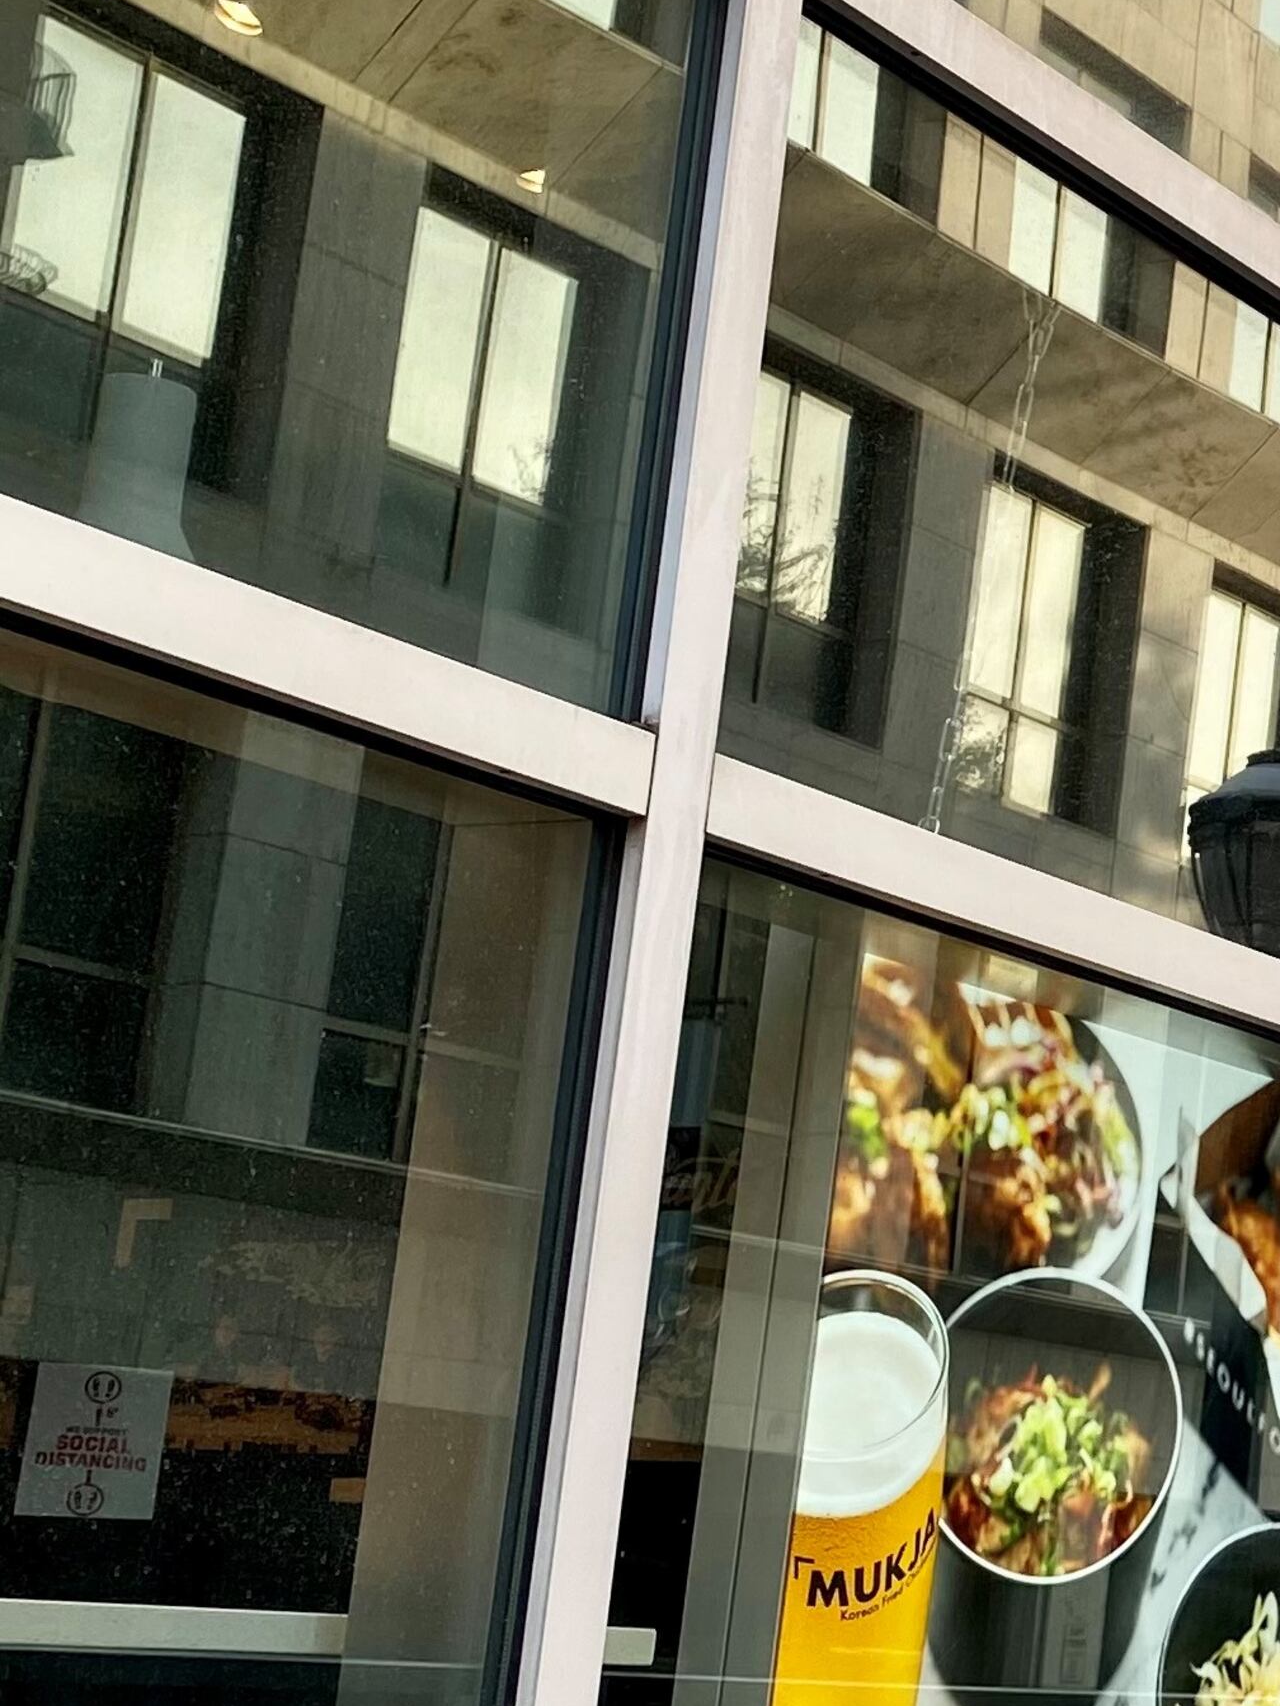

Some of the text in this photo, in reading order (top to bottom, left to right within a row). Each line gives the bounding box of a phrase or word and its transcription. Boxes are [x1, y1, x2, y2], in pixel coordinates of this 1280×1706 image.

[56, 1434, 130, 1455] SOCIAL
[34, 1450, 148, 1473] DISTANCING
[806, 1506, 937, 1608] MUKJA
